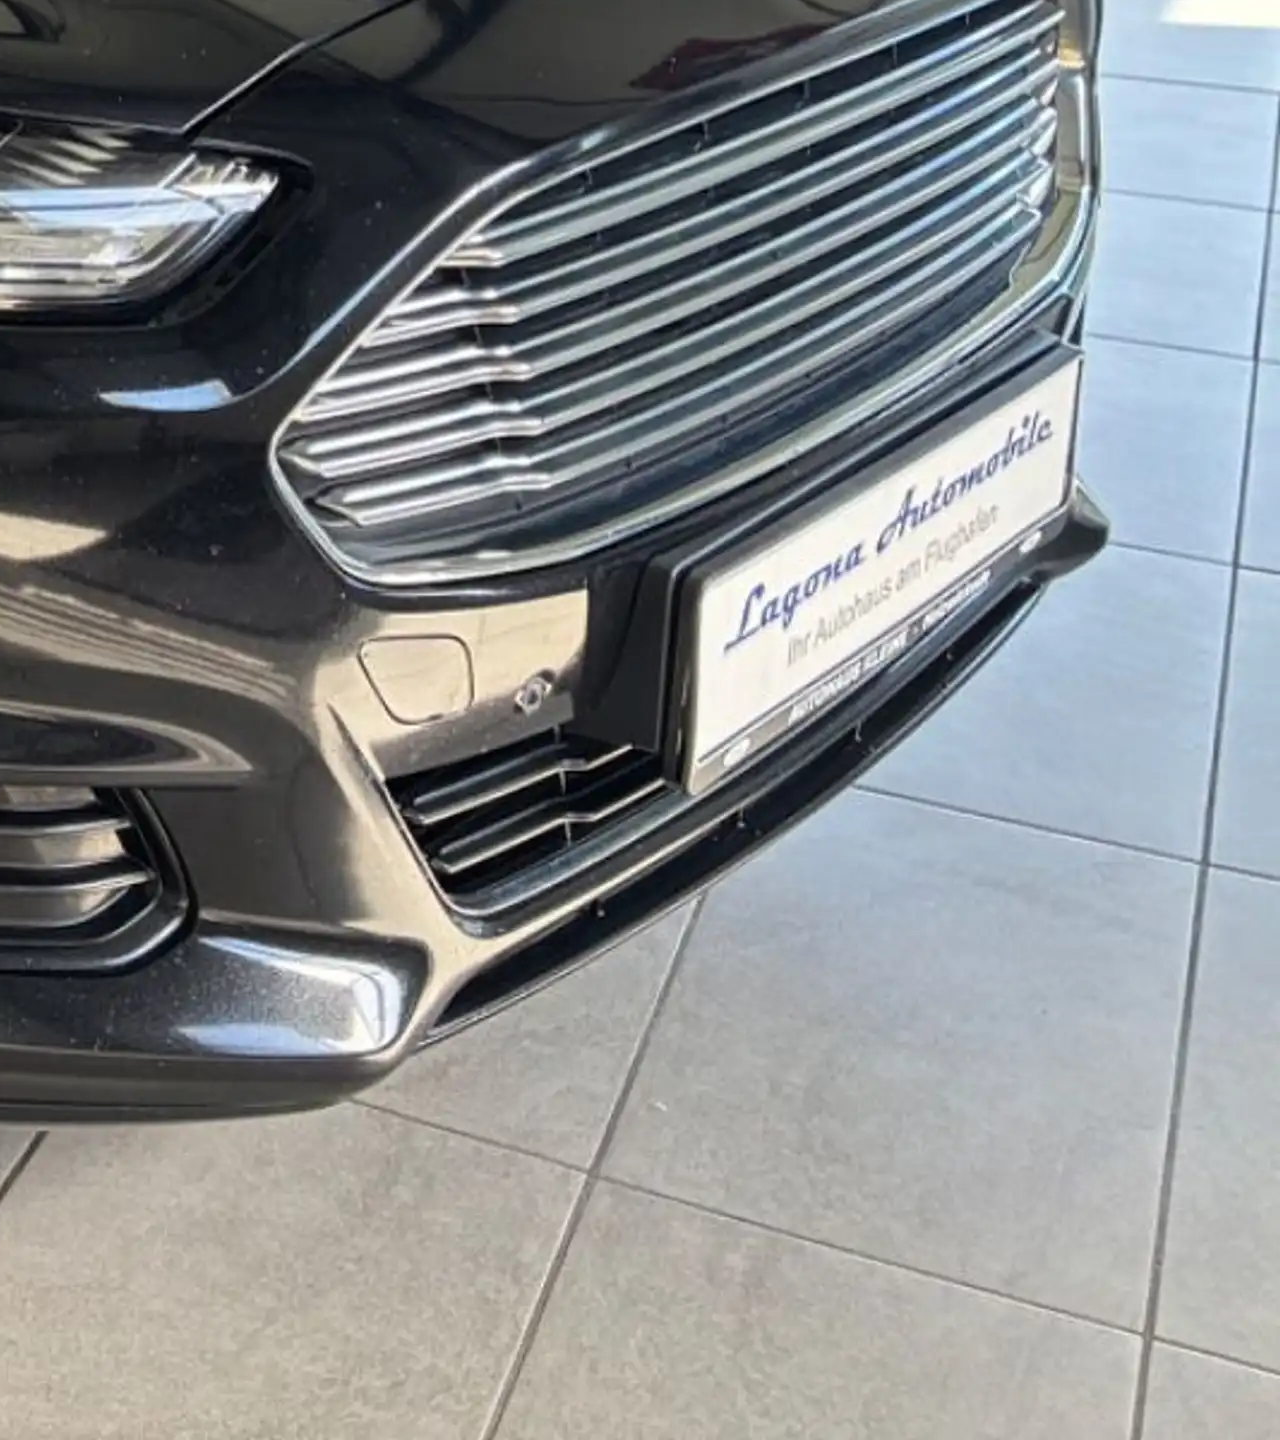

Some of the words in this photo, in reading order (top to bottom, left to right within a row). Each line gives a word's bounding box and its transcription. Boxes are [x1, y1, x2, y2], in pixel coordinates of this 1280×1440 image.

[724, 540, 866, 652] Lagona
[875, 409, 1054, 555] Automobile
[813, 576, 893, 648] Autohaus
[894, 557, 922, 591] am
